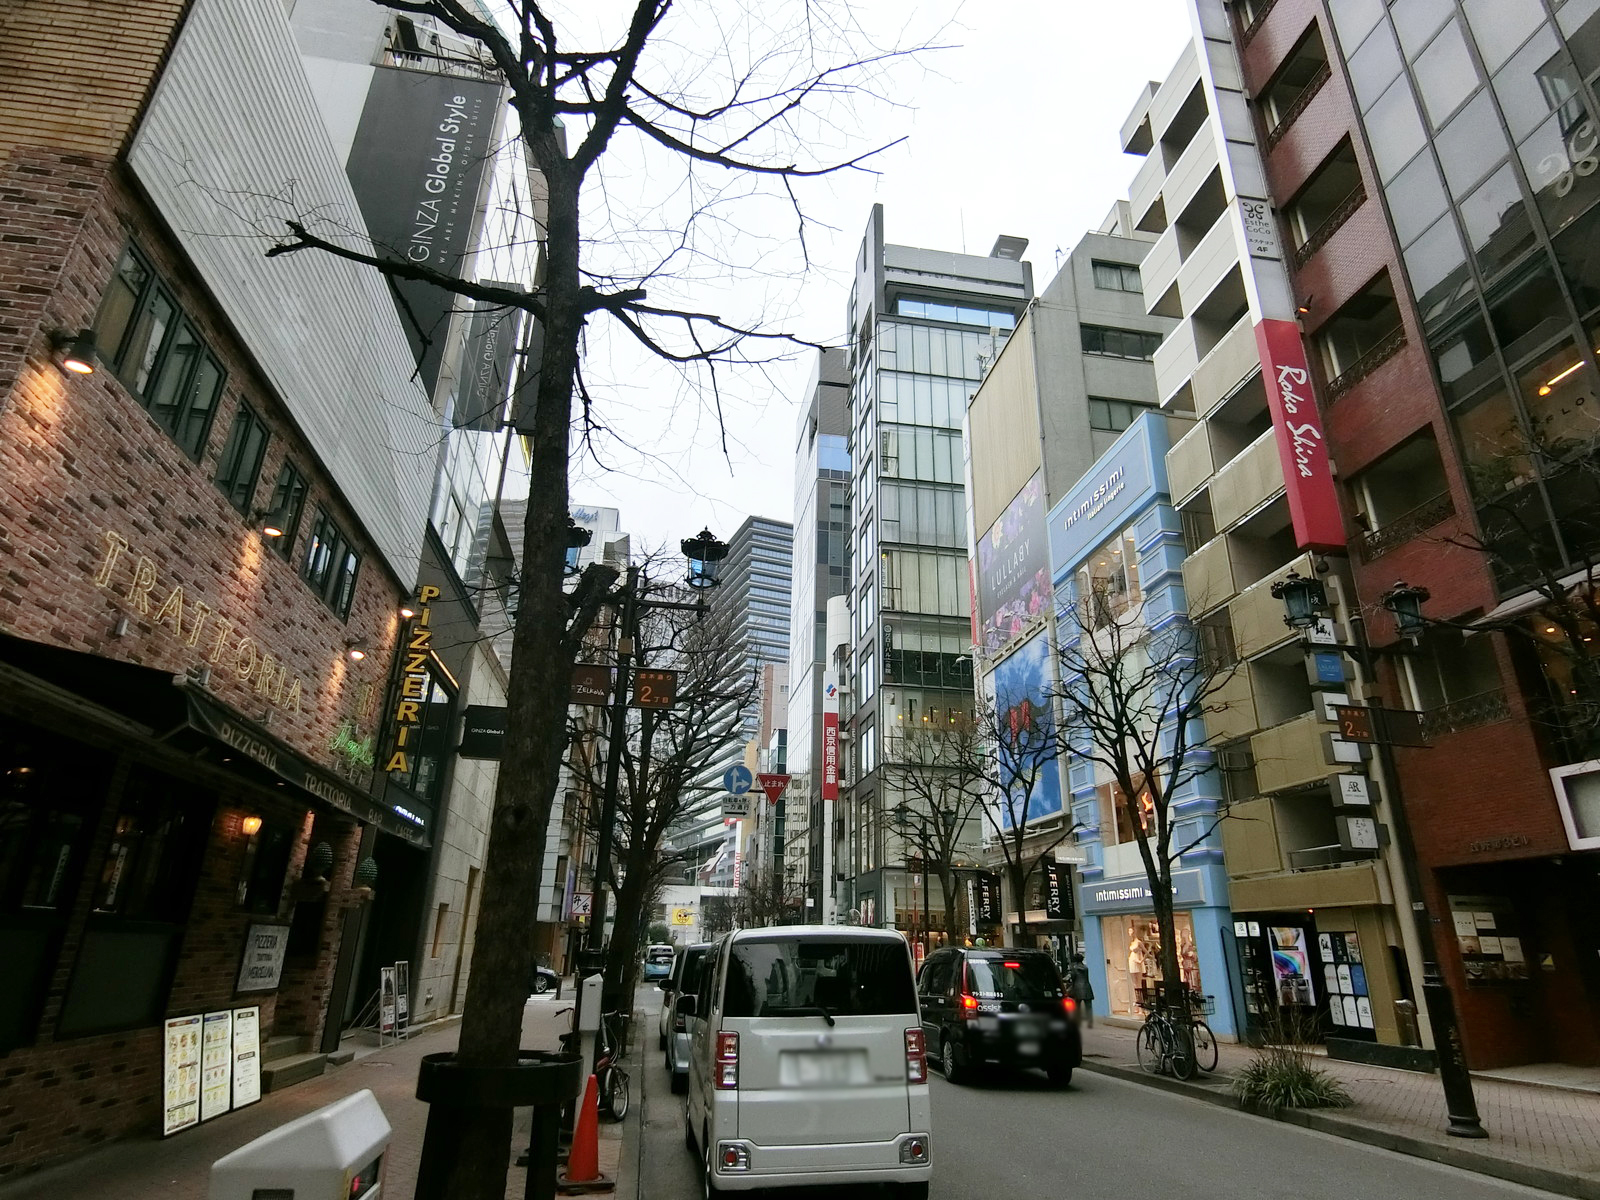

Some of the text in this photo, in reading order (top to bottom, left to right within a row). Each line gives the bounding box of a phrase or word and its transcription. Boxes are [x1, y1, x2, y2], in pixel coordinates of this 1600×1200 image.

[407, 95, 468, 262] GINZA Global Style
[444, 222, 454, 242] ARE
[1244, 218, 1270, 227] Esthe
[1246, 225, 1271, 235] CoCo
[1286, 420, 1321, 478] Shira
[991, 538, 1030, 591] LULLABY
[95, 531, 300, 714] TRATTORIA
[385, 585, 441, 774] PIZZERIA
[220, 722, 278, 773] PIZZERIA
[303, 772, 351, 810] TRATTORIA
[764, 780, 785, 788] 止まれ
[981, 878, 991, 919] J.FERRY
[1047, 865, 1061, 914] J.FERRY
